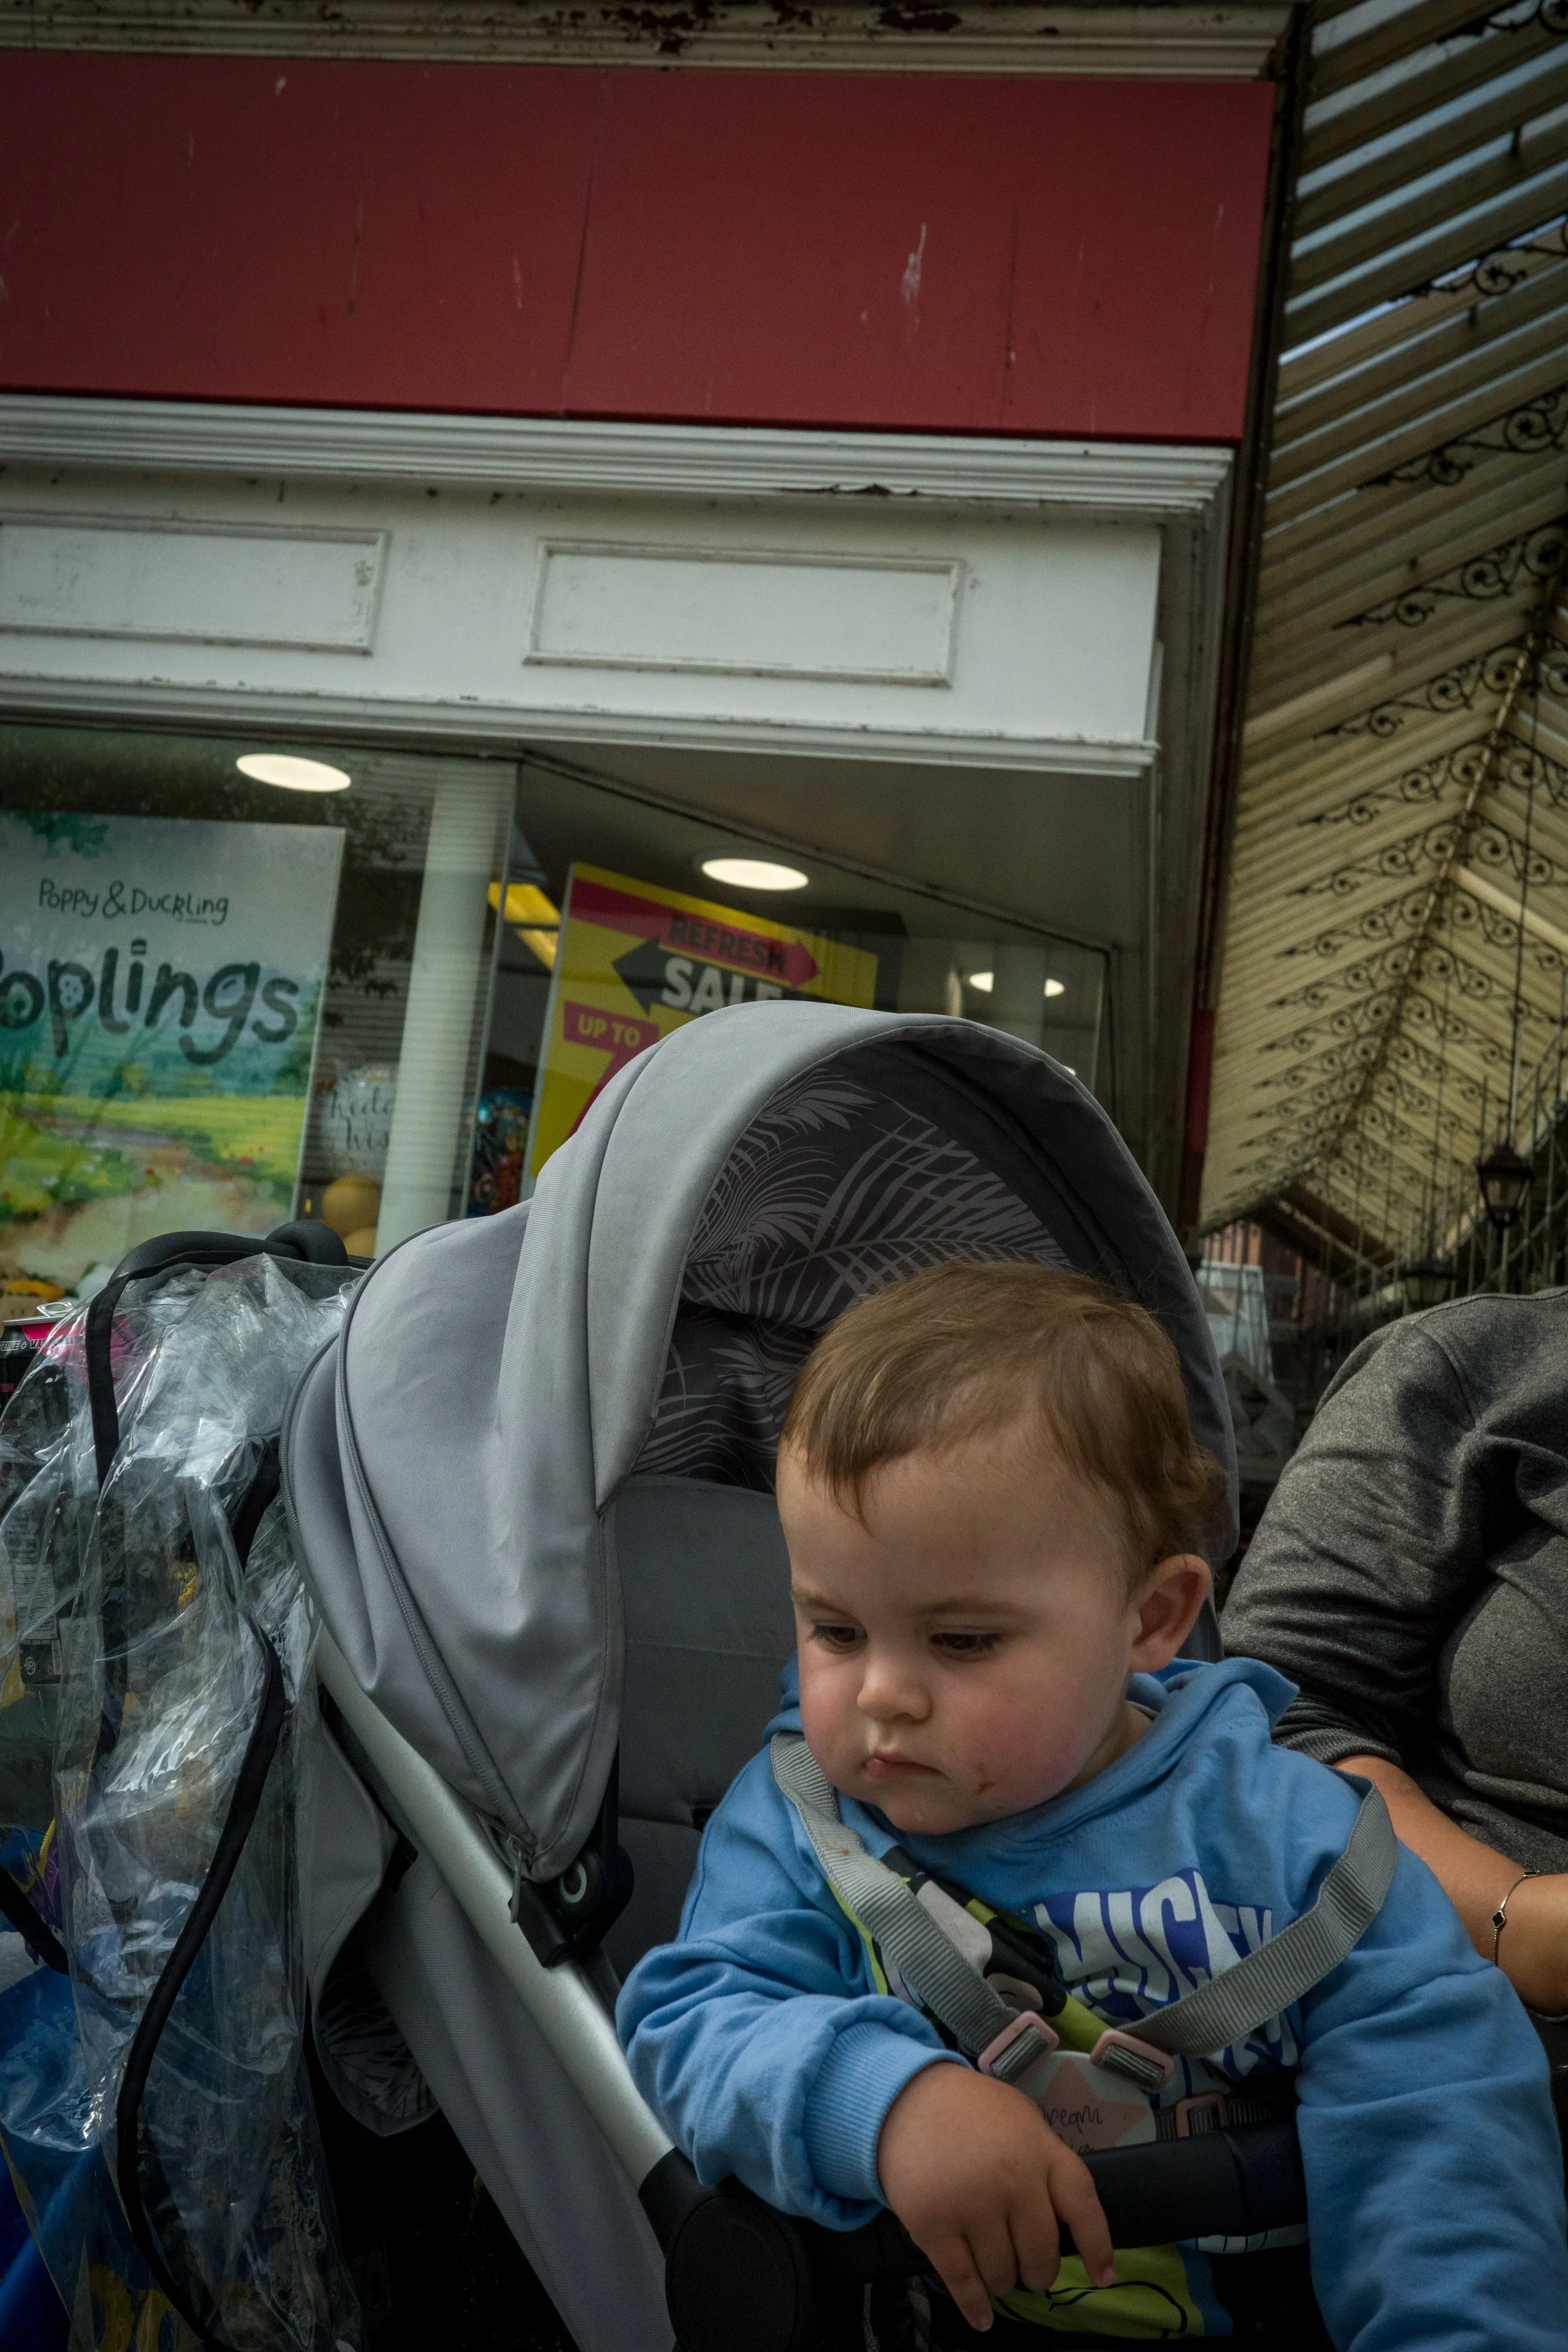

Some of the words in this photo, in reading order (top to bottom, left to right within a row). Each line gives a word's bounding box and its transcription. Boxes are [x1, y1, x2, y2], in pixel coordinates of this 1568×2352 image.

[39, 878, 99, 918] Poppy
[131, 887, 230, 926] Duckling
[669, 913, 787, 973] REFRESH
[0, 938, 300, 1065] oplings
[577, 1013, 607, 1039] UP
[612, 1022, 642, 1048] TO
